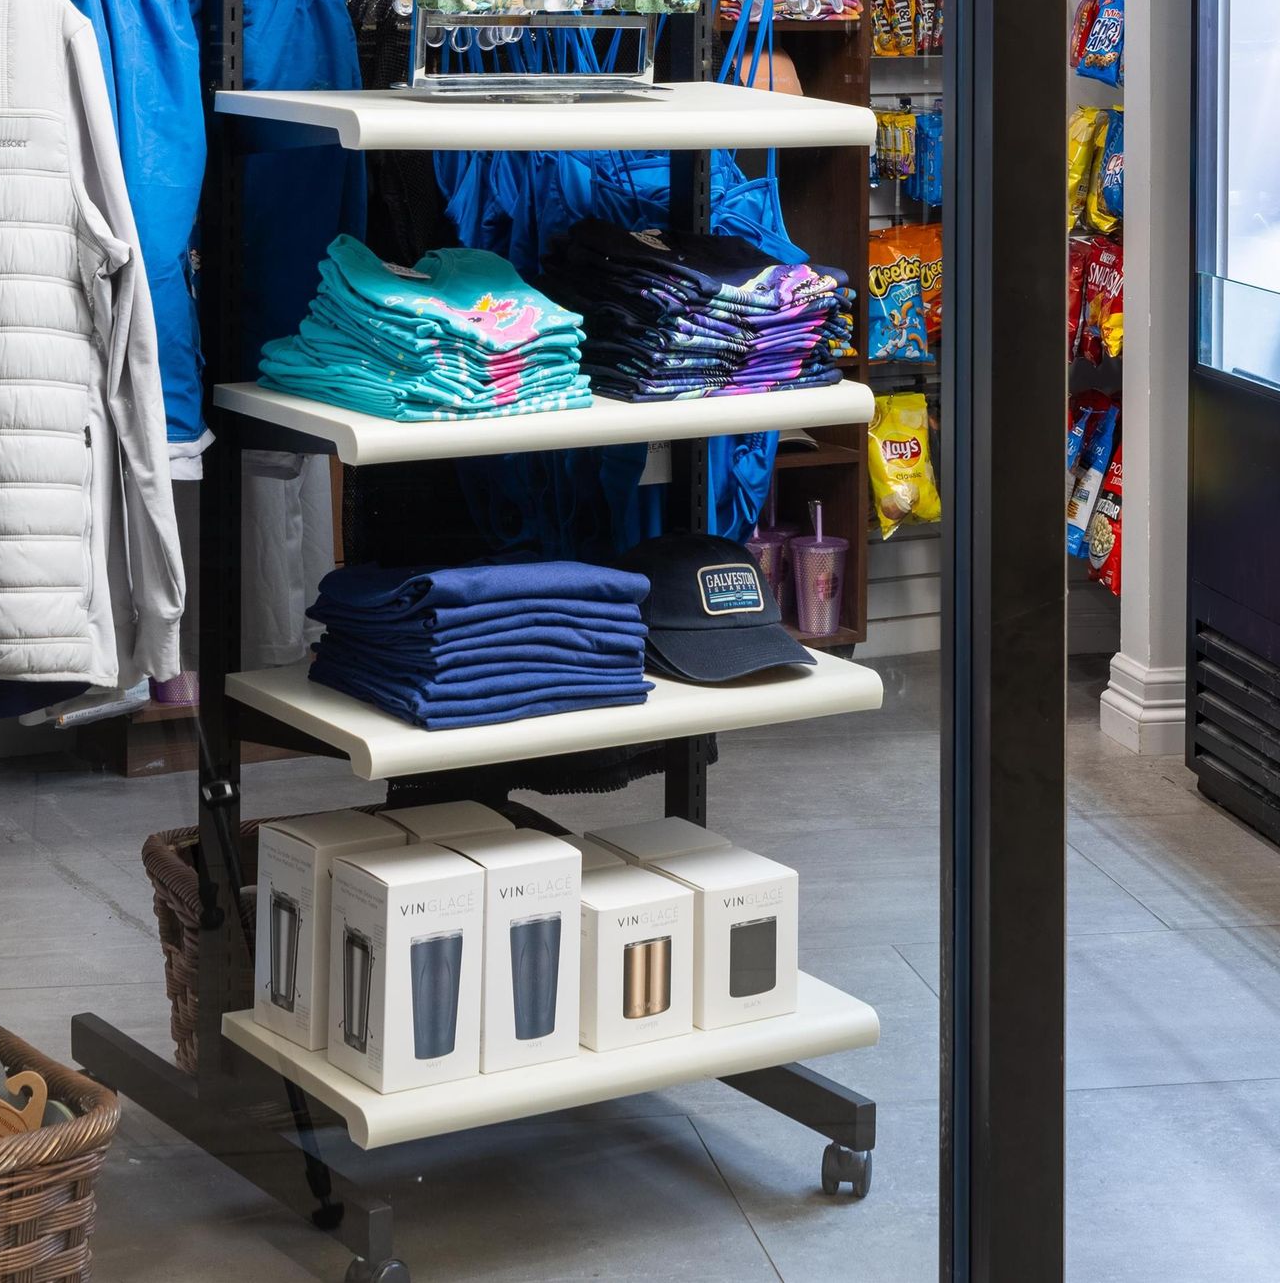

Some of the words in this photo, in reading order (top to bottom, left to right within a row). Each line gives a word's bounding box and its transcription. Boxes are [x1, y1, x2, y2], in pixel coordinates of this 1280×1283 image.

[869, 258, 921, 296] Cheetos
[921, 260, 943, 289] Chee
[705, 572, 756, 588] GALVESTON
[743, 1000, 761, 1009] BLACK
